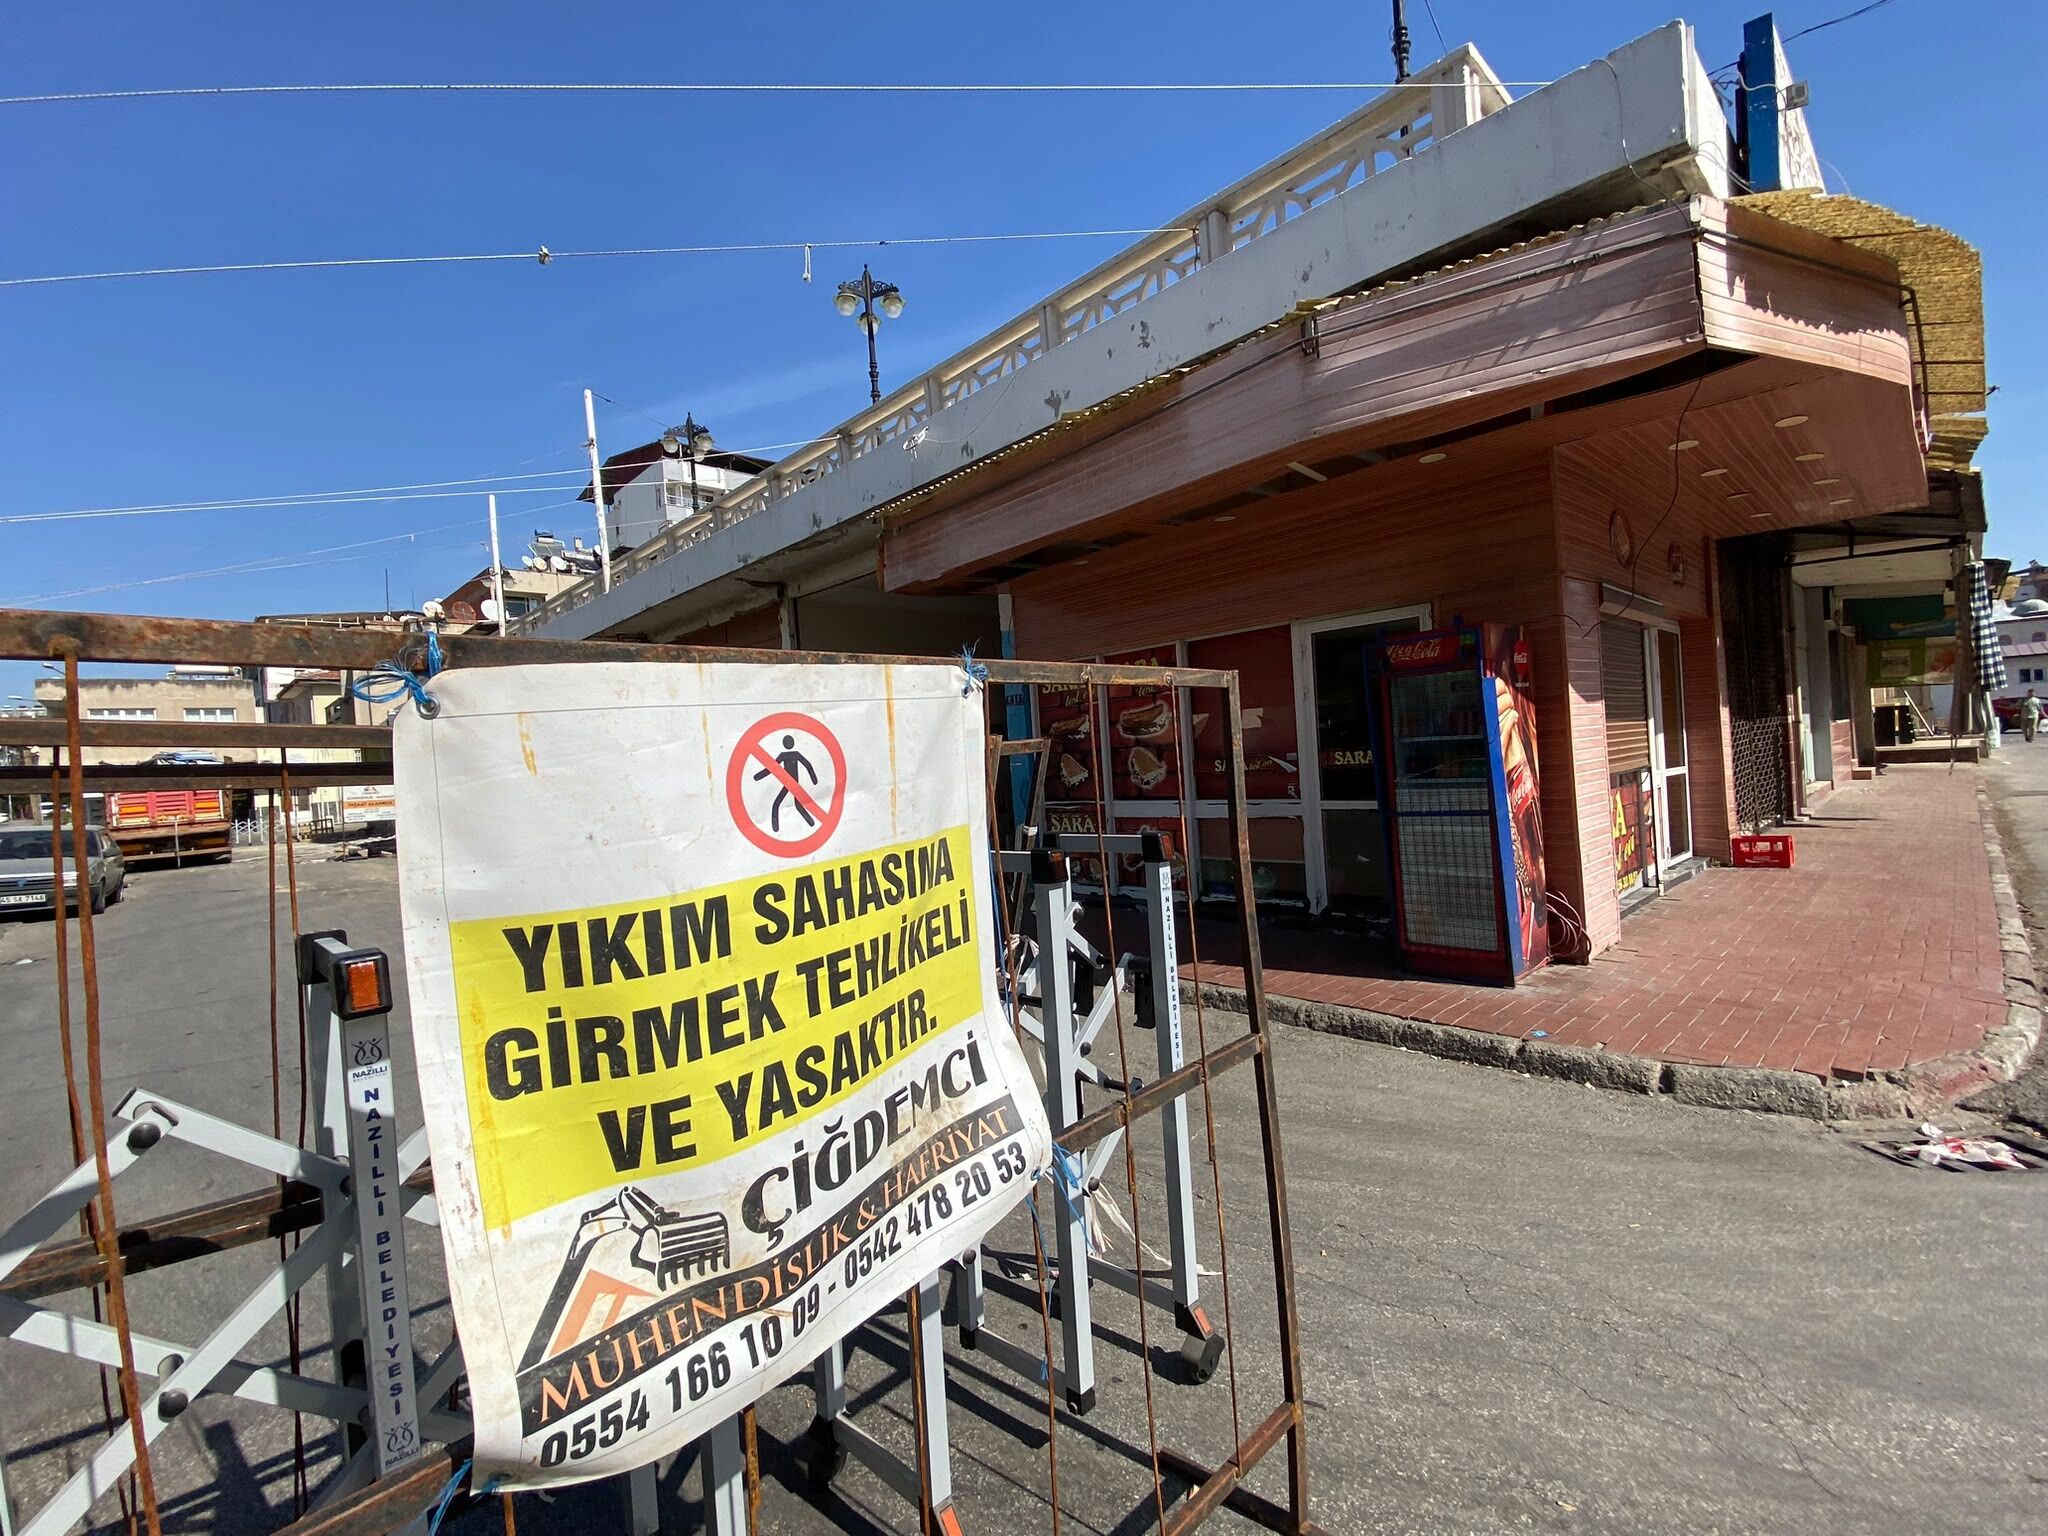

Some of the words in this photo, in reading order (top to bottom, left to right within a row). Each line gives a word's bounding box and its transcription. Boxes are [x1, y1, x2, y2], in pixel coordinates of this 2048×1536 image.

[1387, 638, 1441, 662] Coca-Cola
[1050, 814, 1096, 833] SARA
[1334, 751, 1373, 765] SARA
[485, 970, 786, 1101] GİRMEK
[796, 888, 971, 1018] TEHLİKELİ
[502, 895, 732, 993] YIKIM
[753, 837, 955, 945] SAHASINA
[597, 1094, 697, 1172] VE
[715, 988, 938, 1142] YASAKTIR.
[741, 1030, 988, 1252] ÇİĞDEMCİ
[539, 1217, 853, 1424] MÜHENDİSLİK
[854, 1197, 878, 1228] &
[881, 1105, 1011, 1213] HAFRİYAT
[539, 1388, 650, 1469] 0554
[665, 1347, 731, 1414] 166
[739, 1309, 784, 1367] 10
[792, 1294, 820, 1338] 09
[844, 1225, 902, 1289] 0542
[907, 1183, 950, 1242] 478
[955, 1162, 992, 1204] 20
[999, 1141, 1026, 1185] 53
